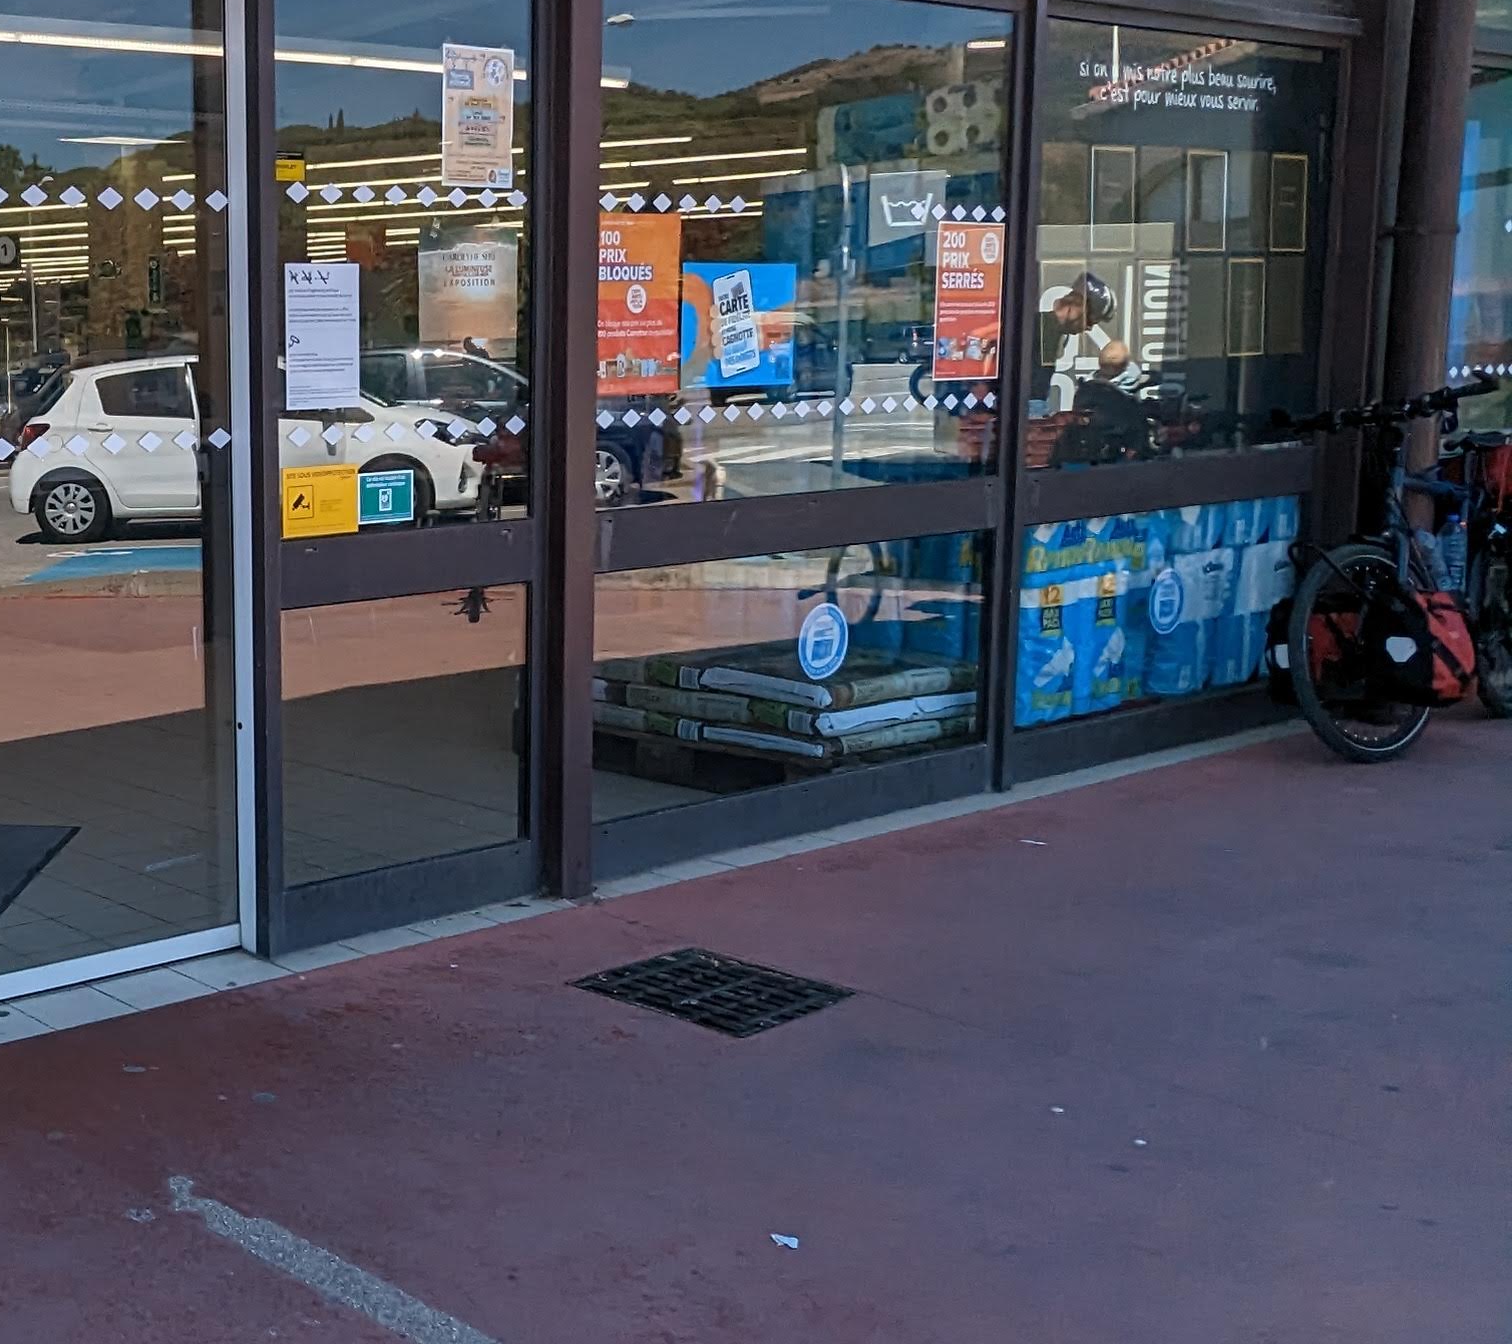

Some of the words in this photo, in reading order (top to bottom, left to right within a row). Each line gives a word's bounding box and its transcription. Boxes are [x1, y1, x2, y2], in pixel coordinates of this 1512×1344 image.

[1079, 59, 1089, 77] si
[1093, 65, 1108, 78] on
[1123, 62, 1144, 81] mis
[1146, 64, 1177, 84] notre
[1181, 64, 1205, 91] plus
[1208, 65, 1235, 88] beau
[1237, 73, 1277, 97] sourire,
[1099, 81, 1130, 103] c'est
[1133, 88, 1162, 111] pour
[1164, 90, 1198, 109] mieux
[1200, 94, 1224, 110] vous
[1227, 94, 1260, 112] servir.
[600, 230, 621, 246] 100
[943, 231, 966, 249] 200
[599, 248, 627, 263] PRIX
[942, 252, 970, 268] PRIX
[598, 262, 653, 281] BLOQUÉS
[941, 267, 985, 289] SERRÉS
[443, 278, 496, 287] EXPOSITION
[719, 293, 750, 316] CARTE
[1042, 585, 1061, 605] 12
